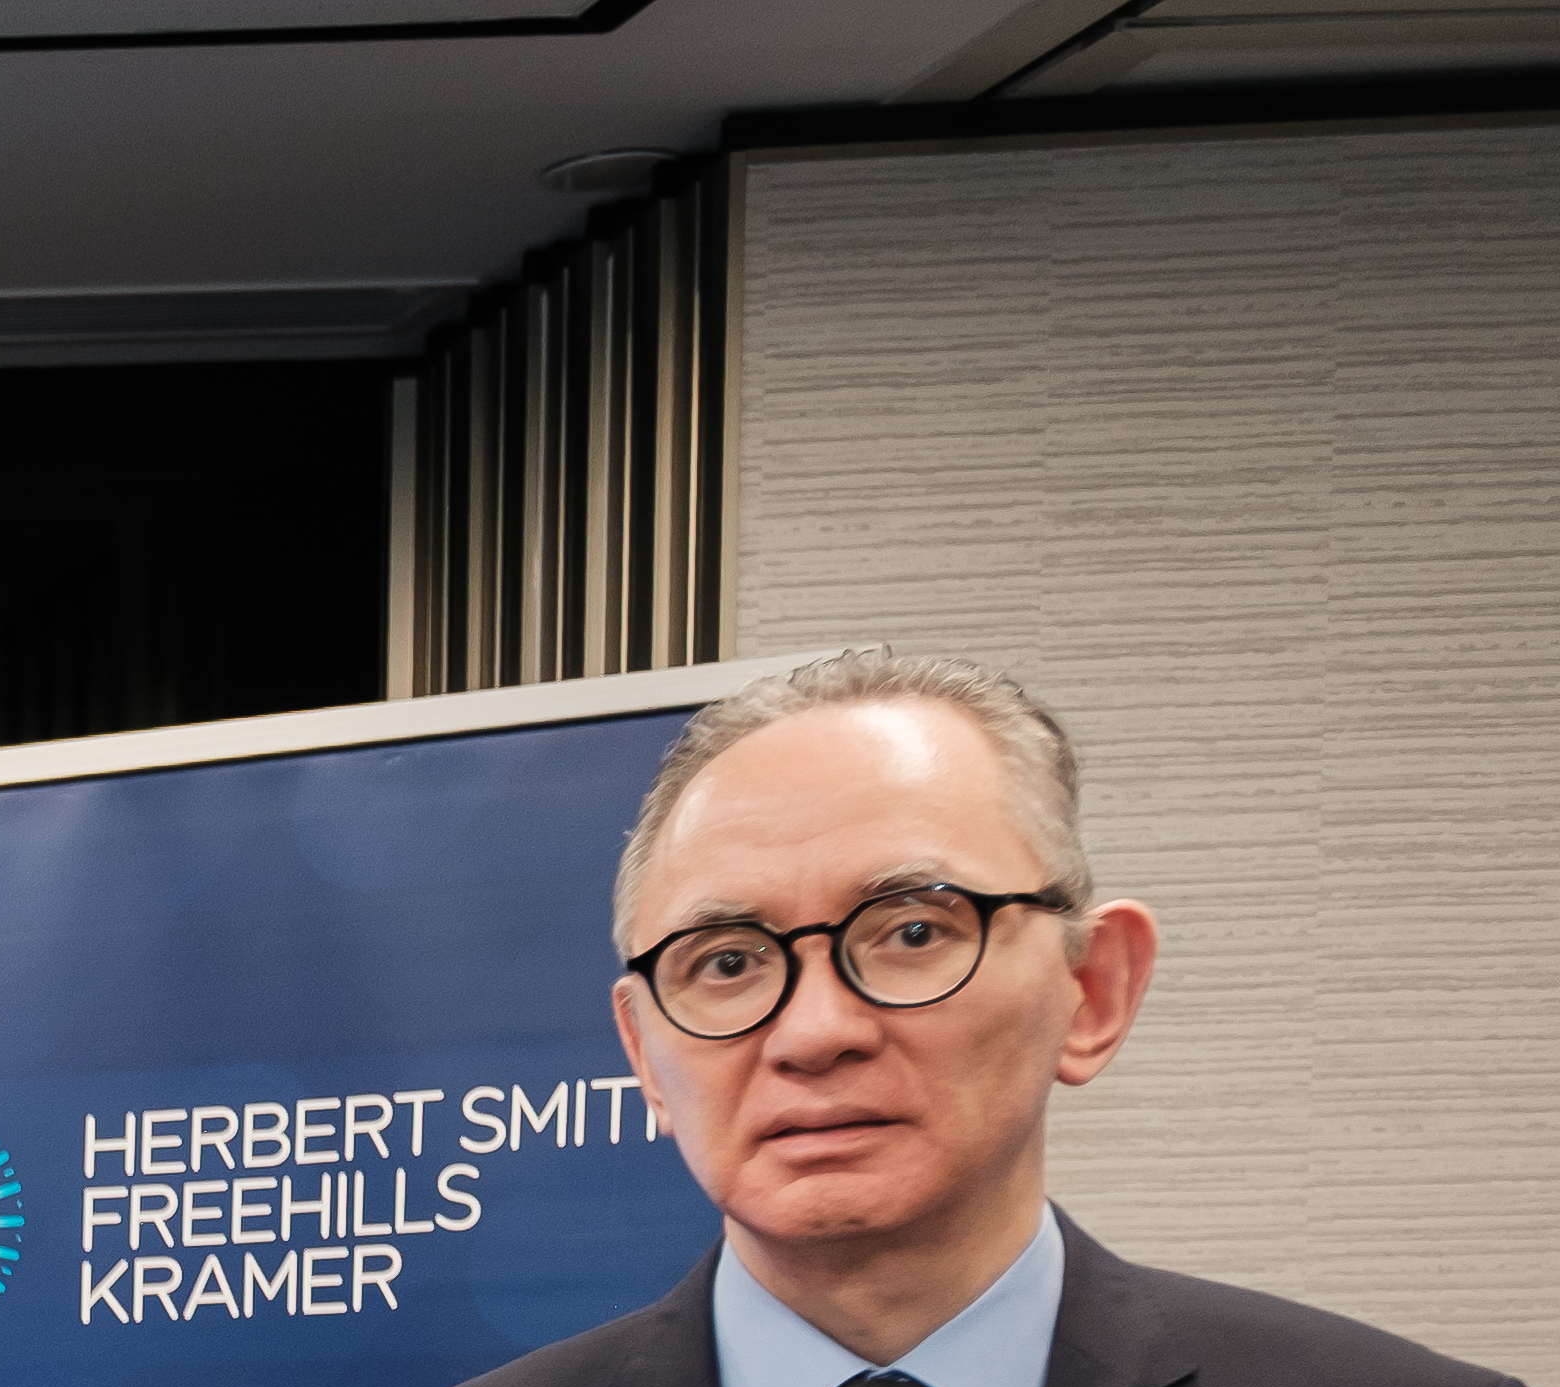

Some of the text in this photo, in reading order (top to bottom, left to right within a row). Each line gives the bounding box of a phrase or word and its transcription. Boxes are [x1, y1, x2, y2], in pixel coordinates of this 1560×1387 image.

[83, 1088, 445, 1179] HERBERT
[81, 1162, 483, 1254] FREEHILLS
[79, 1243, 403, 1326] KRAMER
